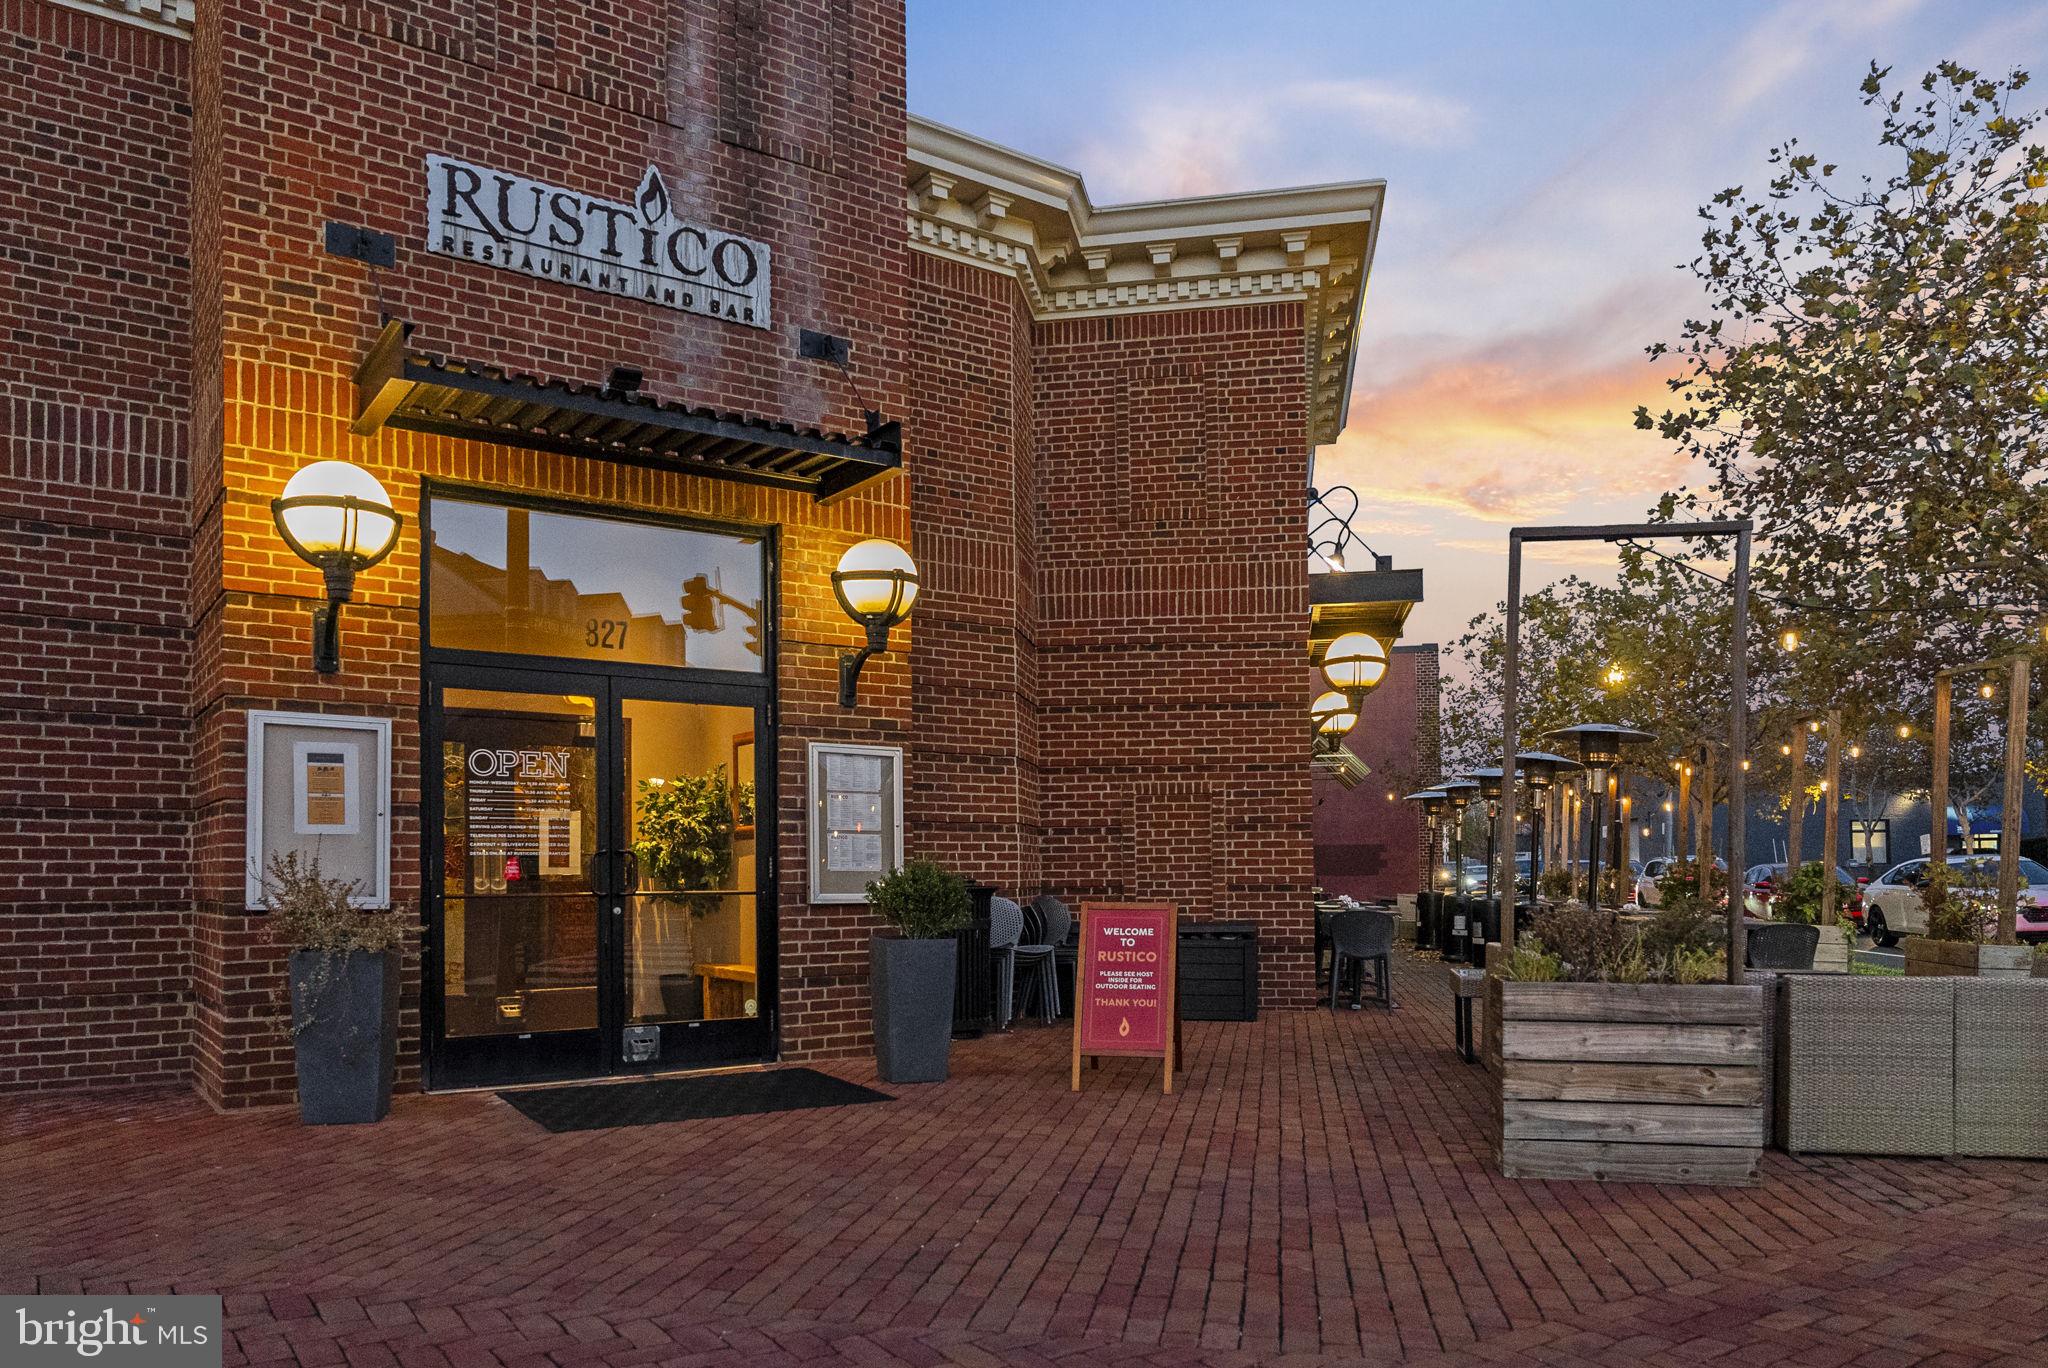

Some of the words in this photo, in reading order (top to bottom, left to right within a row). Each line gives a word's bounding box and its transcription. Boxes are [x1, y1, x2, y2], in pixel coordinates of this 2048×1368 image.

[441, 163, 758, 288] RUSTICO
[442, 235, 628, 293] RESTAURANT
[645, 284, 693, 307] AND
[709, 299, 755, 323] BAR
[586, 618, 628, 650] 827
[469, 749, 570, 778] OPEN
[1103, 927, 1154, 936] WELCOME
[1120, 938, 1136, 947] TO
[1097, 951, 1157, 963] RUSTICO
[1094, 997, 1130, 1007] THANK
[1132, 998, 1157, 1008] YOU!
